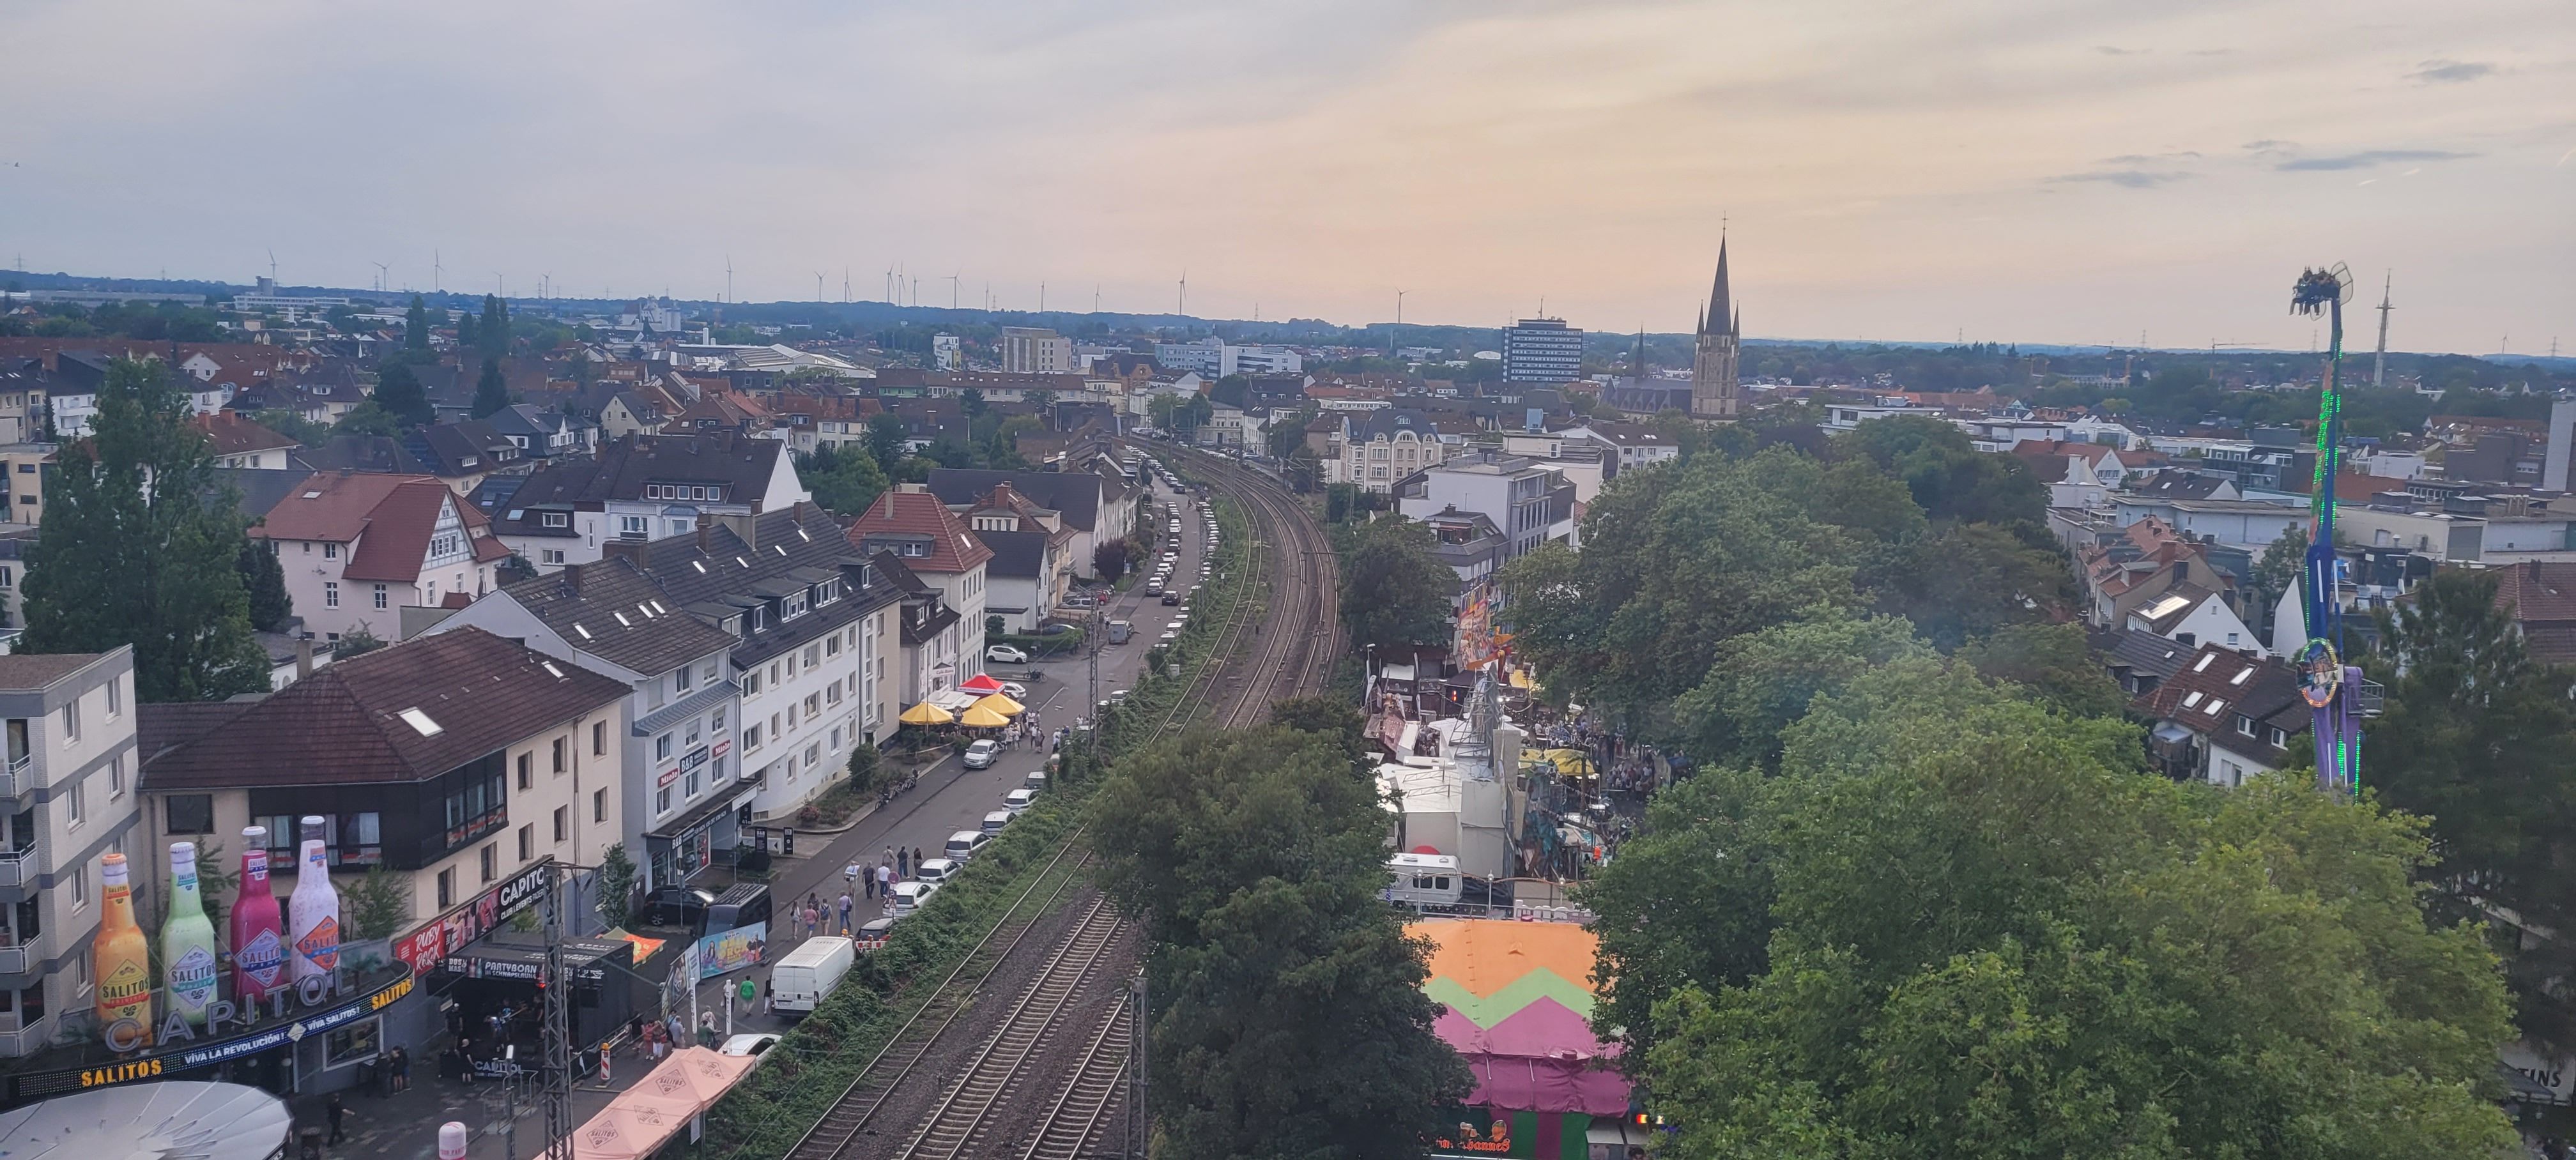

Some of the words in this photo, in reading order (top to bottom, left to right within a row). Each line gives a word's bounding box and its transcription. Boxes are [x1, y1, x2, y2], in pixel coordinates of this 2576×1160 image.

[715, 742, 731, 755] Miele
[681, 756, 693, 773] B&B
[661, 771, 678, 786] Miele
[672, 834, 682, 850] B&B
[500, 866, 544, 906] CAPITO
[500, 907, 513, 920] CLUB
[516, 895, 532, 912] EVENTS
[415, 924, 441, 952] RUBY
[242, 947, 279, 963] SALITO
[416, 942, 440, 970] ROCK
[172, 962, 215, 982] SALITOS
[485, 961, 537, 973] PARTYBORN
[103, 977, 149, 998] SALITOS
[371, 978, 412, 1011] SALITOS
[105, 966, 355, 1053] CAPITOL
[209, 1049, 222, 1059] LA
[81, 1059, 162, 1087] SALITOS
